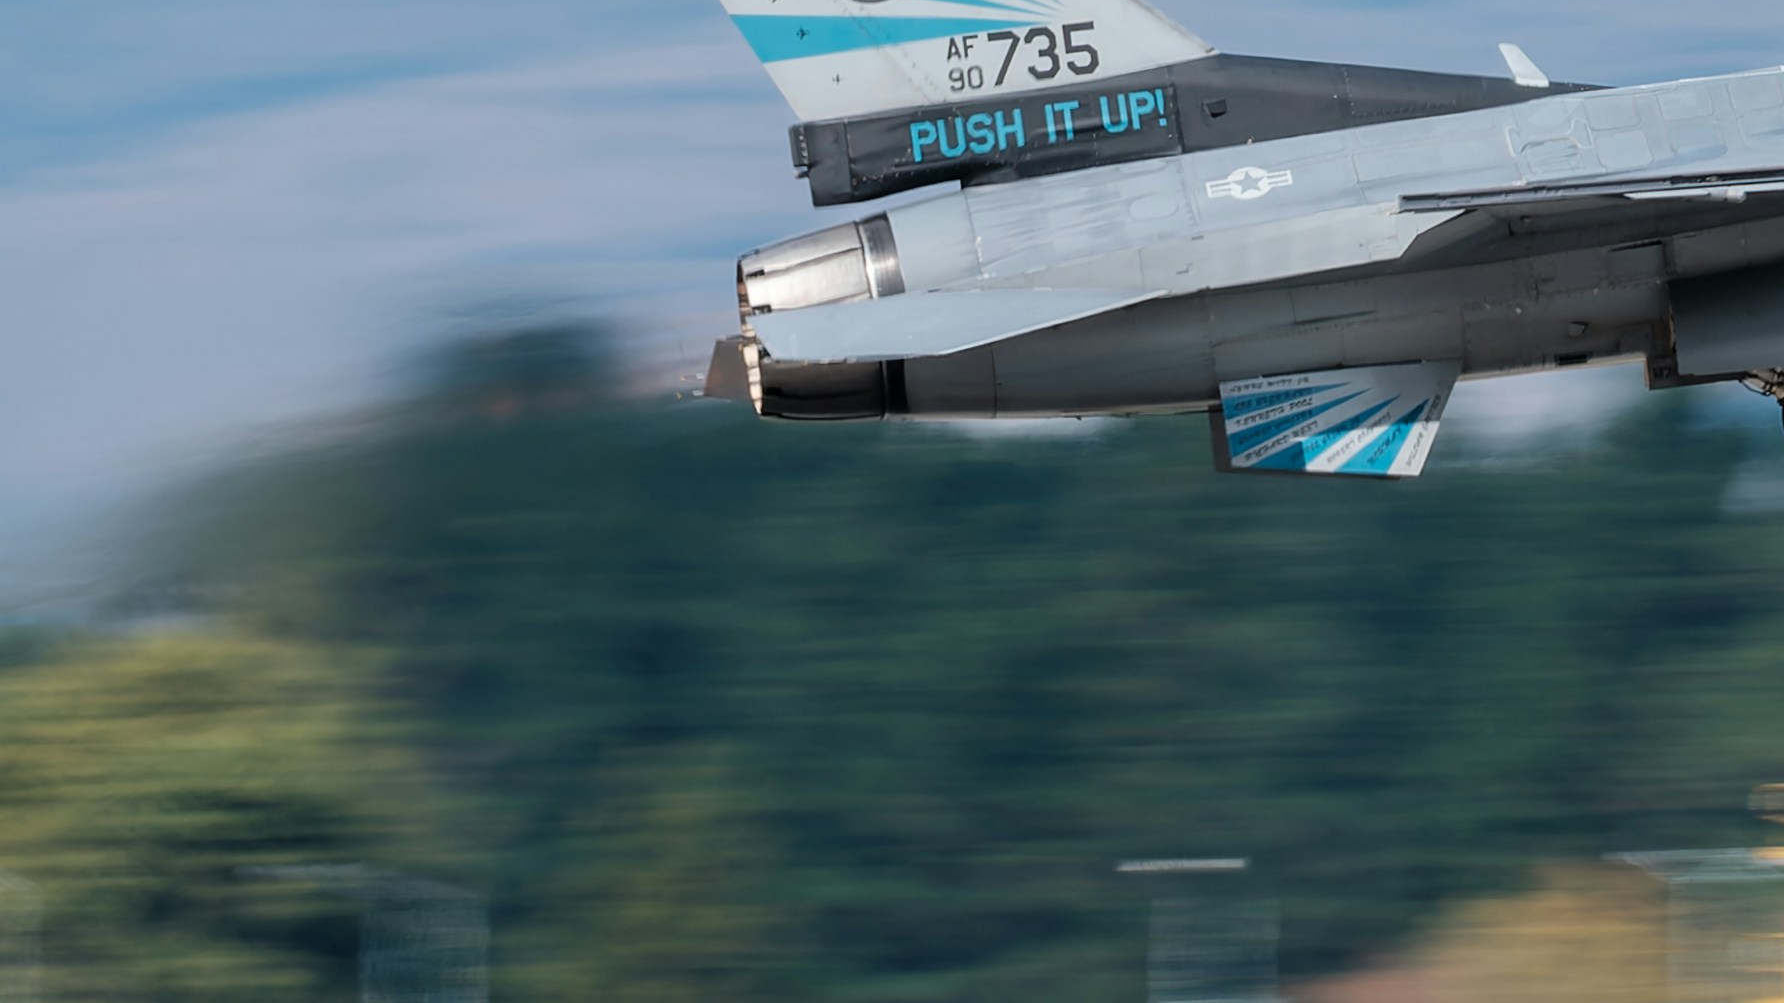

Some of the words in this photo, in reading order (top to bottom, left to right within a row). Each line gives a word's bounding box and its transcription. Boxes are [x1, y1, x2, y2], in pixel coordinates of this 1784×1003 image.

[947, 34, 978, 62] AF
[986, 20, 1099, 87] 735
[948, 65, 984, 92] 90
[909, 107, 1025, 163] PUSH
[1044, 100, 1080, 143] IT
[1098, 88, 1168, 133] UP!
